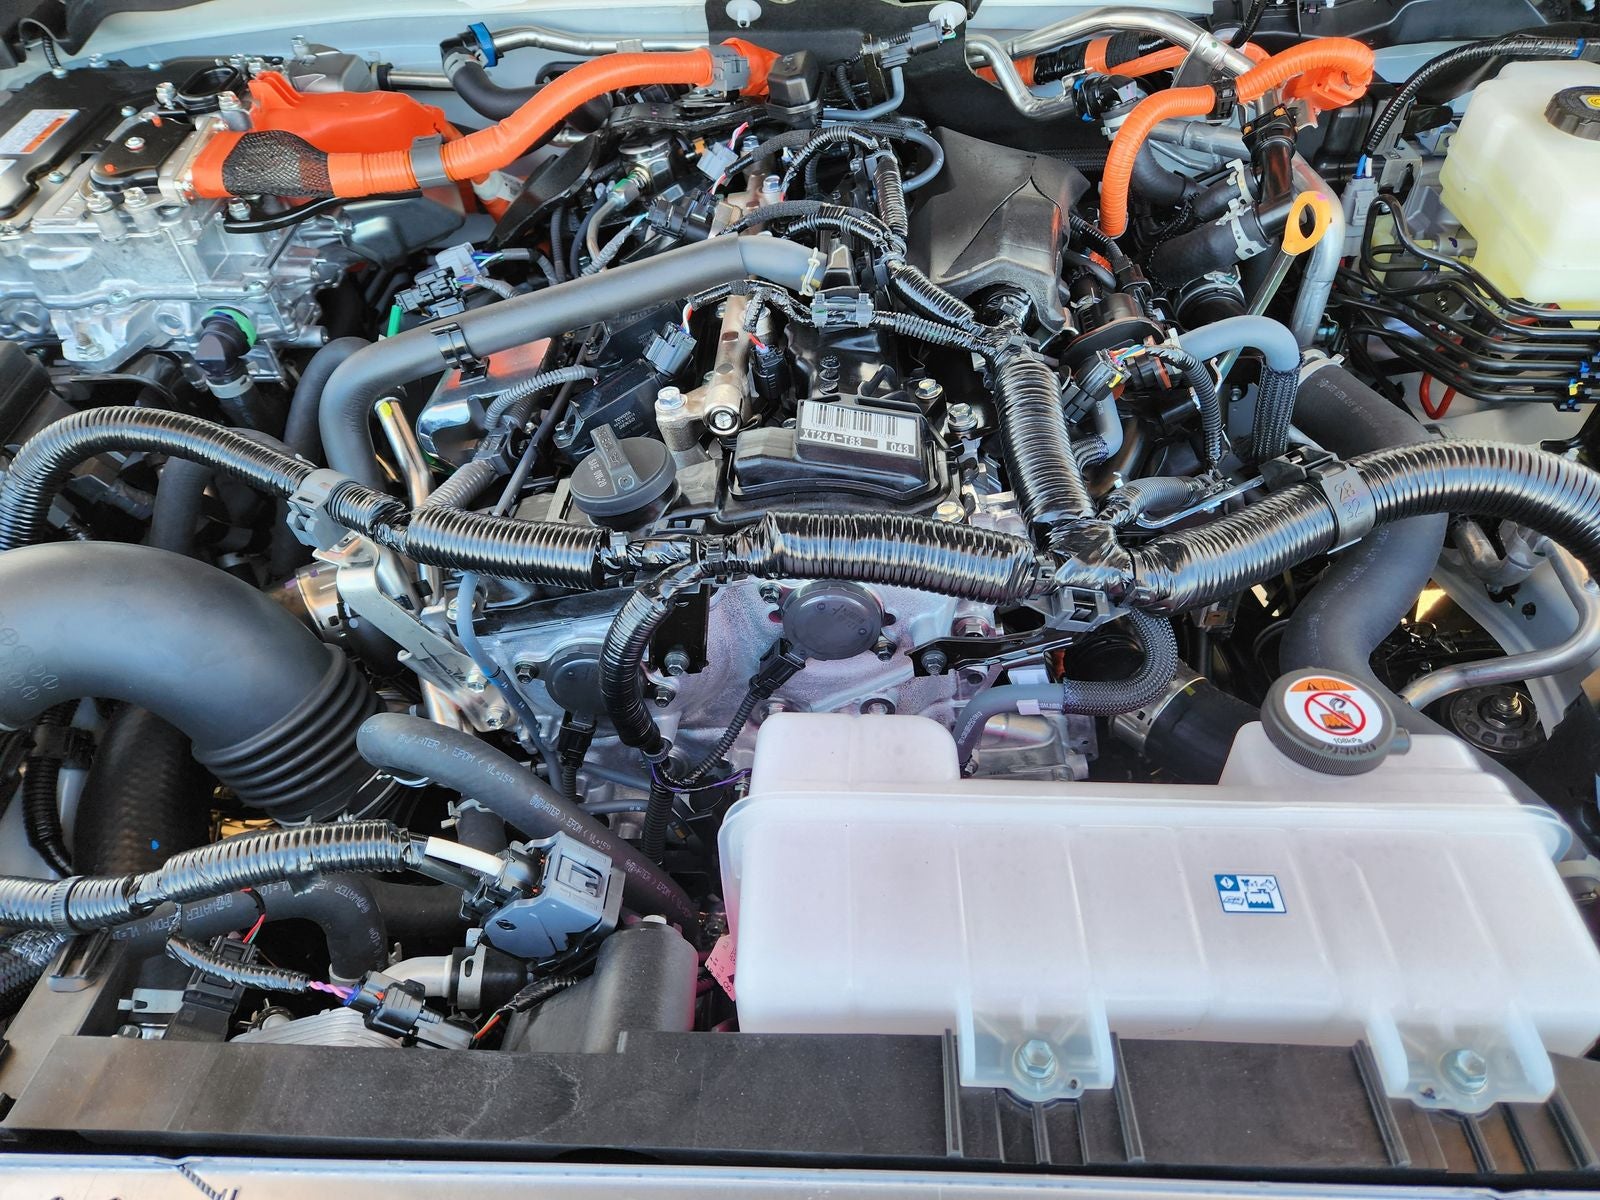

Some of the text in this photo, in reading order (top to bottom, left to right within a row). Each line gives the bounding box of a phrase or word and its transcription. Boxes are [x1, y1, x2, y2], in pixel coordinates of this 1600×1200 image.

[803, 428, 862, 447] XT24A-T83
[890, 442, 910, 454] 043
[587, 458, 607, 488] SAE 0W-20
